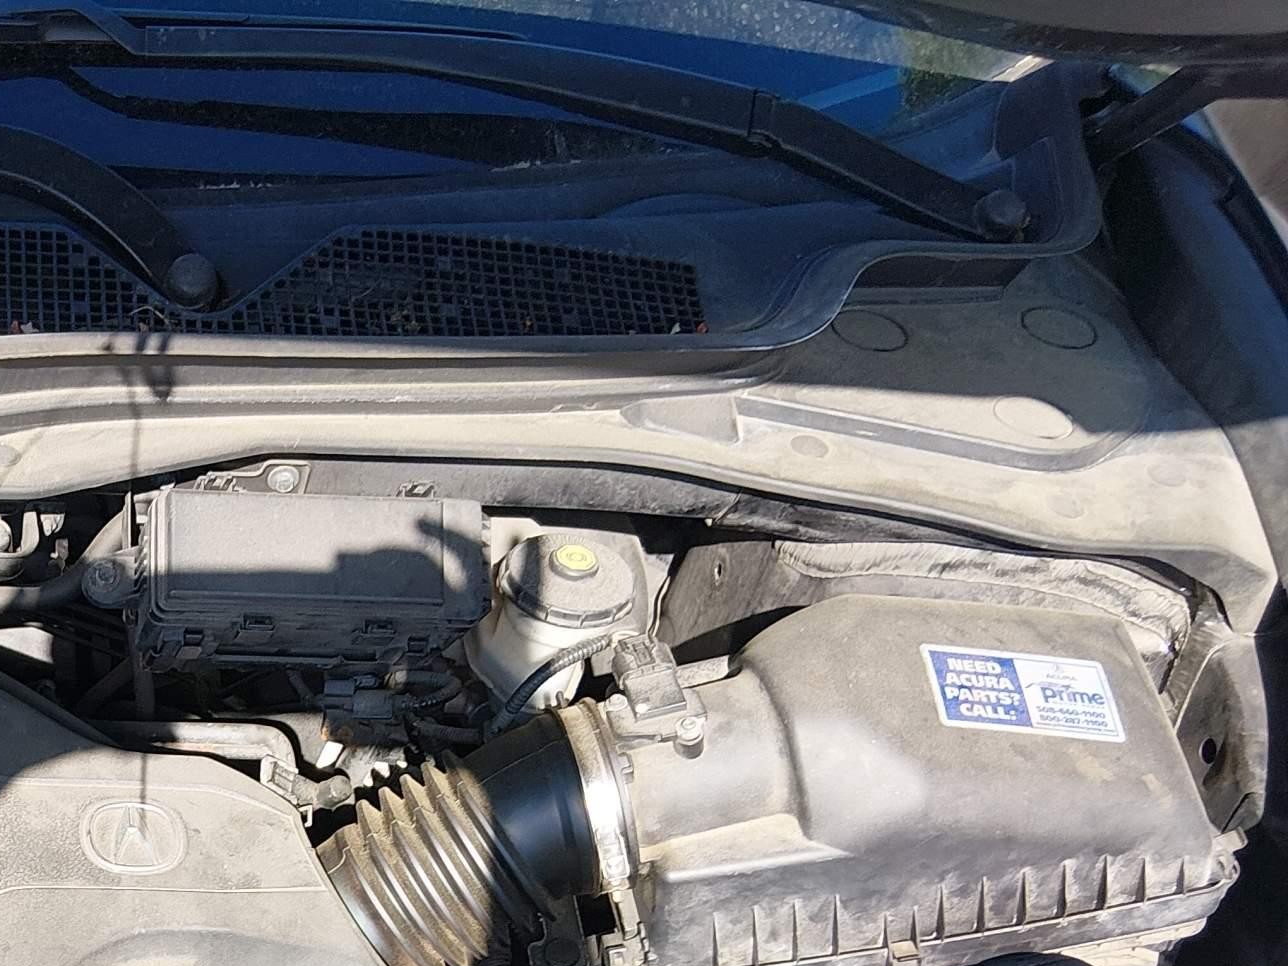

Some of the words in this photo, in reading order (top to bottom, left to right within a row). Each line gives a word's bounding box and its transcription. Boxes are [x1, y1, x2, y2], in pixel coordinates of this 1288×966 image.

[948, 659, 1001, 673] NEED
[945, 673, 1014, 690] ACURA
[945, 687, 1020, 705] PARTS?
[960, 703, 1017, 720] CALL:
